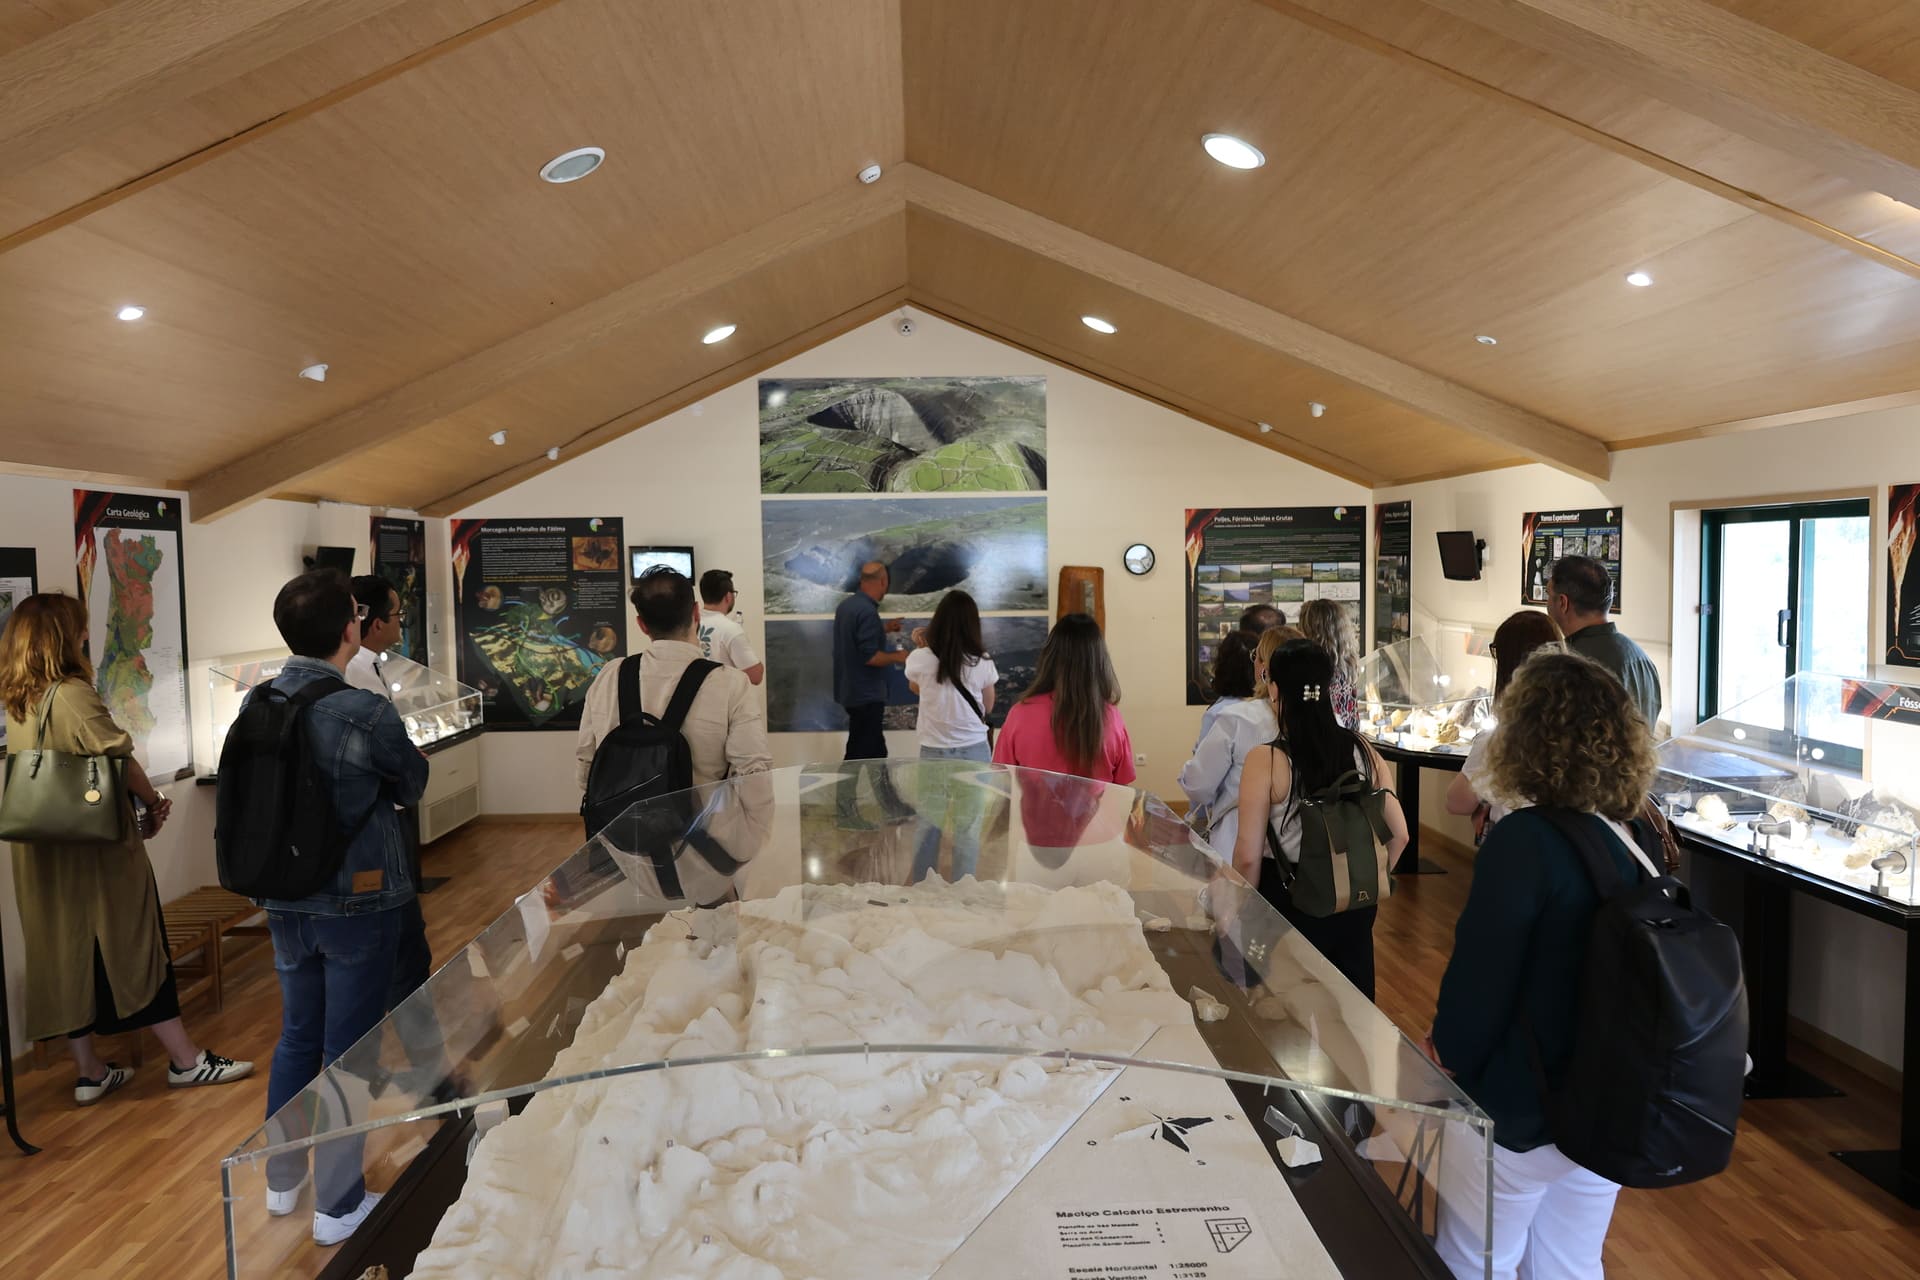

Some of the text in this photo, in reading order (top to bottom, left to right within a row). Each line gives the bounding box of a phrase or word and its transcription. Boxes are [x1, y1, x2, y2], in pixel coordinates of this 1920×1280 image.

[106, 507, 150, 520] Carta Geológica
[547, 525, 566, 533] Fátima
[1899, 696, 1920, 710] Fóss
[1102, 1208, 1153, 1216] Calcário
[1156, 1205, 1230, 1214] Estremenho
[1105, 1264, 1158, 1272] Horizontal
